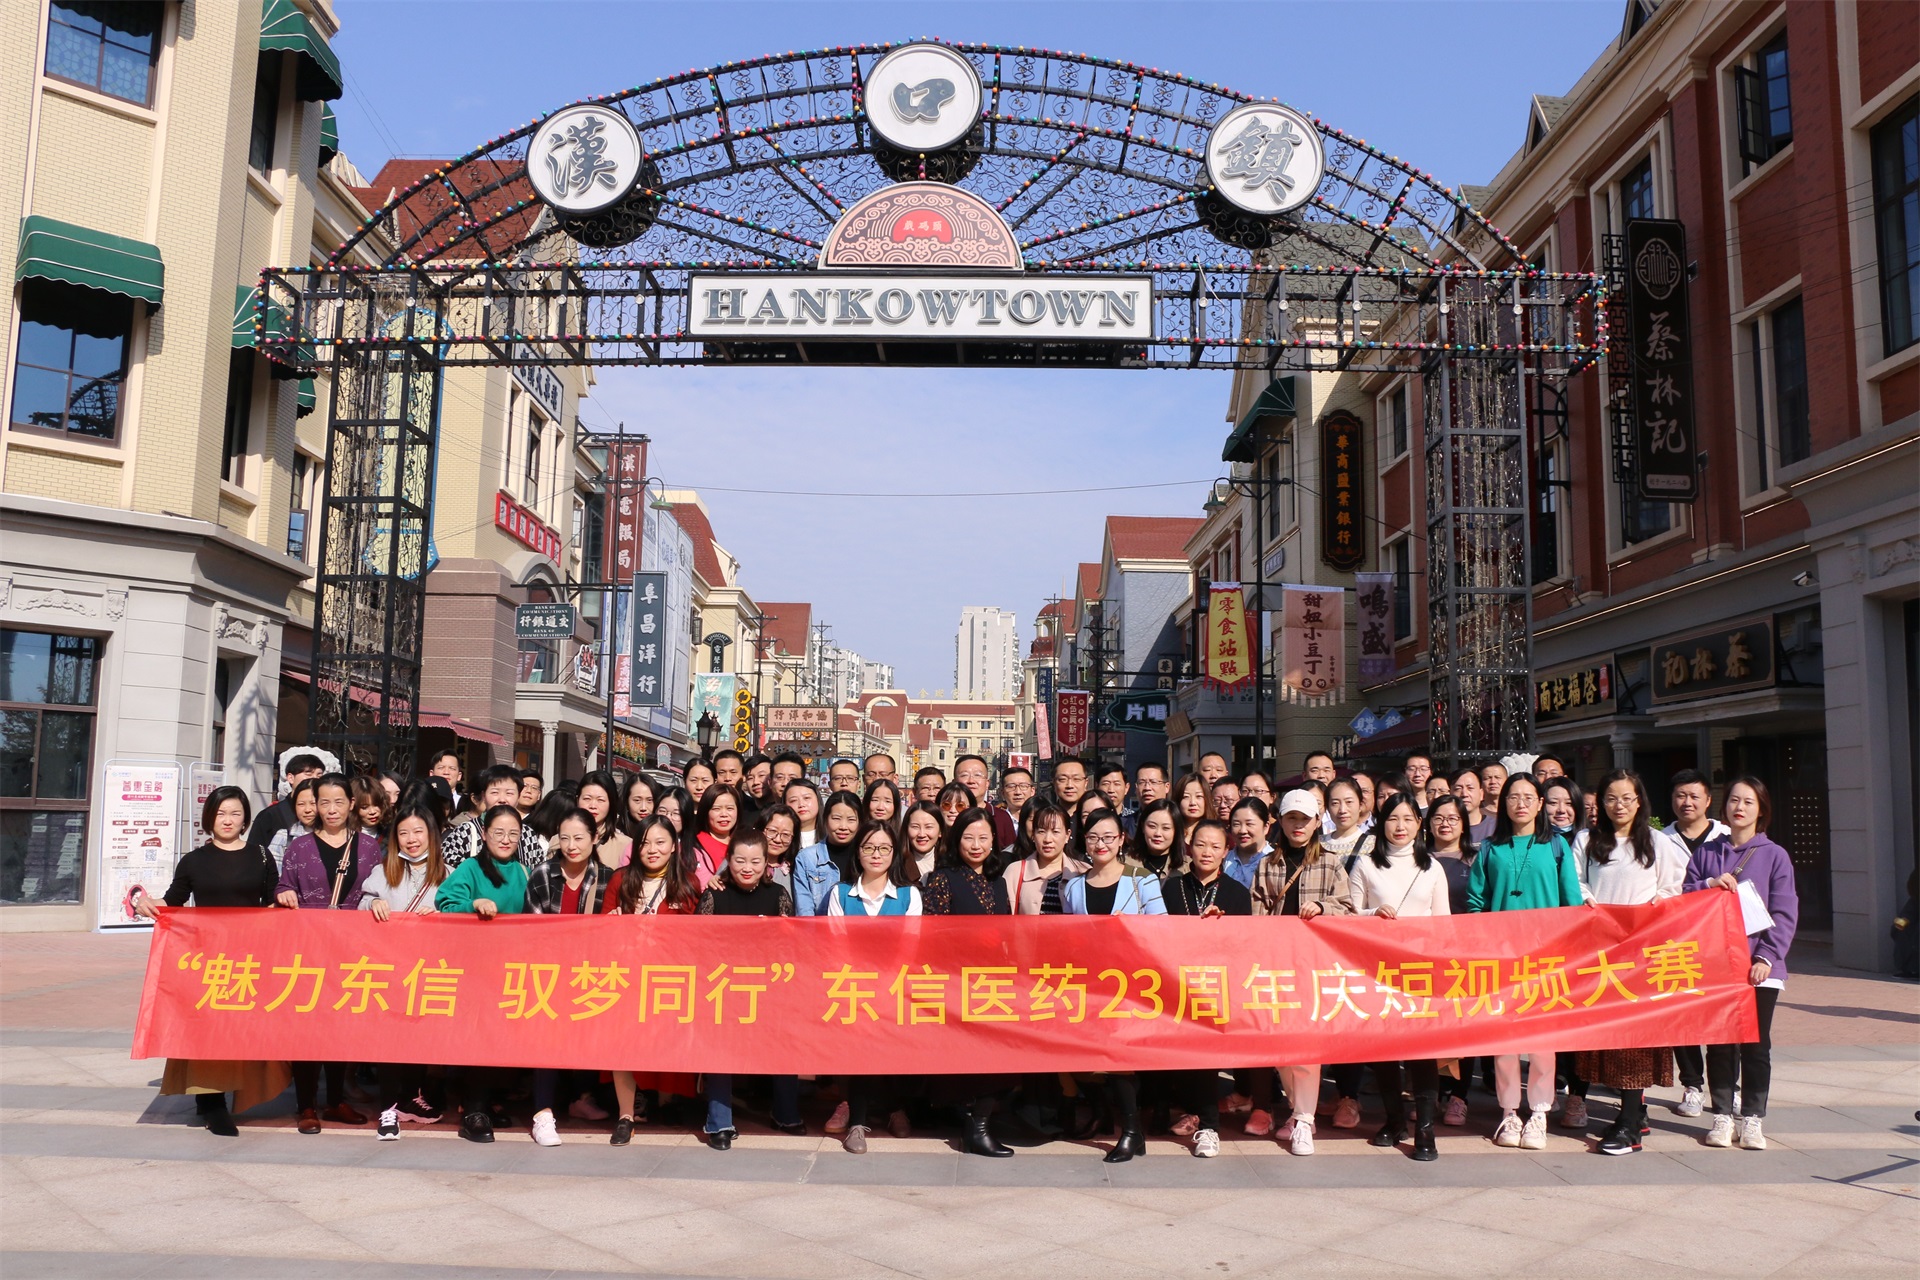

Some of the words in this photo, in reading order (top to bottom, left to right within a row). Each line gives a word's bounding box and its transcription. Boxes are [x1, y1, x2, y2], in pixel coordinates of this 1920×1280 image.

[547, 115, 619, 199] 漢
[891, 78, 956, 123] 口
[1220, 117, 1303, 204] 鎮
[701, 287, 1139, 328] HANKOWTOWN
[638, 583, 659, 695] 阜昌洋行
[1217, 596, 1239, 678] 零食站點
[1302, 593, 1324, 675] 甜妞小豆丁
[1359, 583, 1391, 656] 鳴盛
